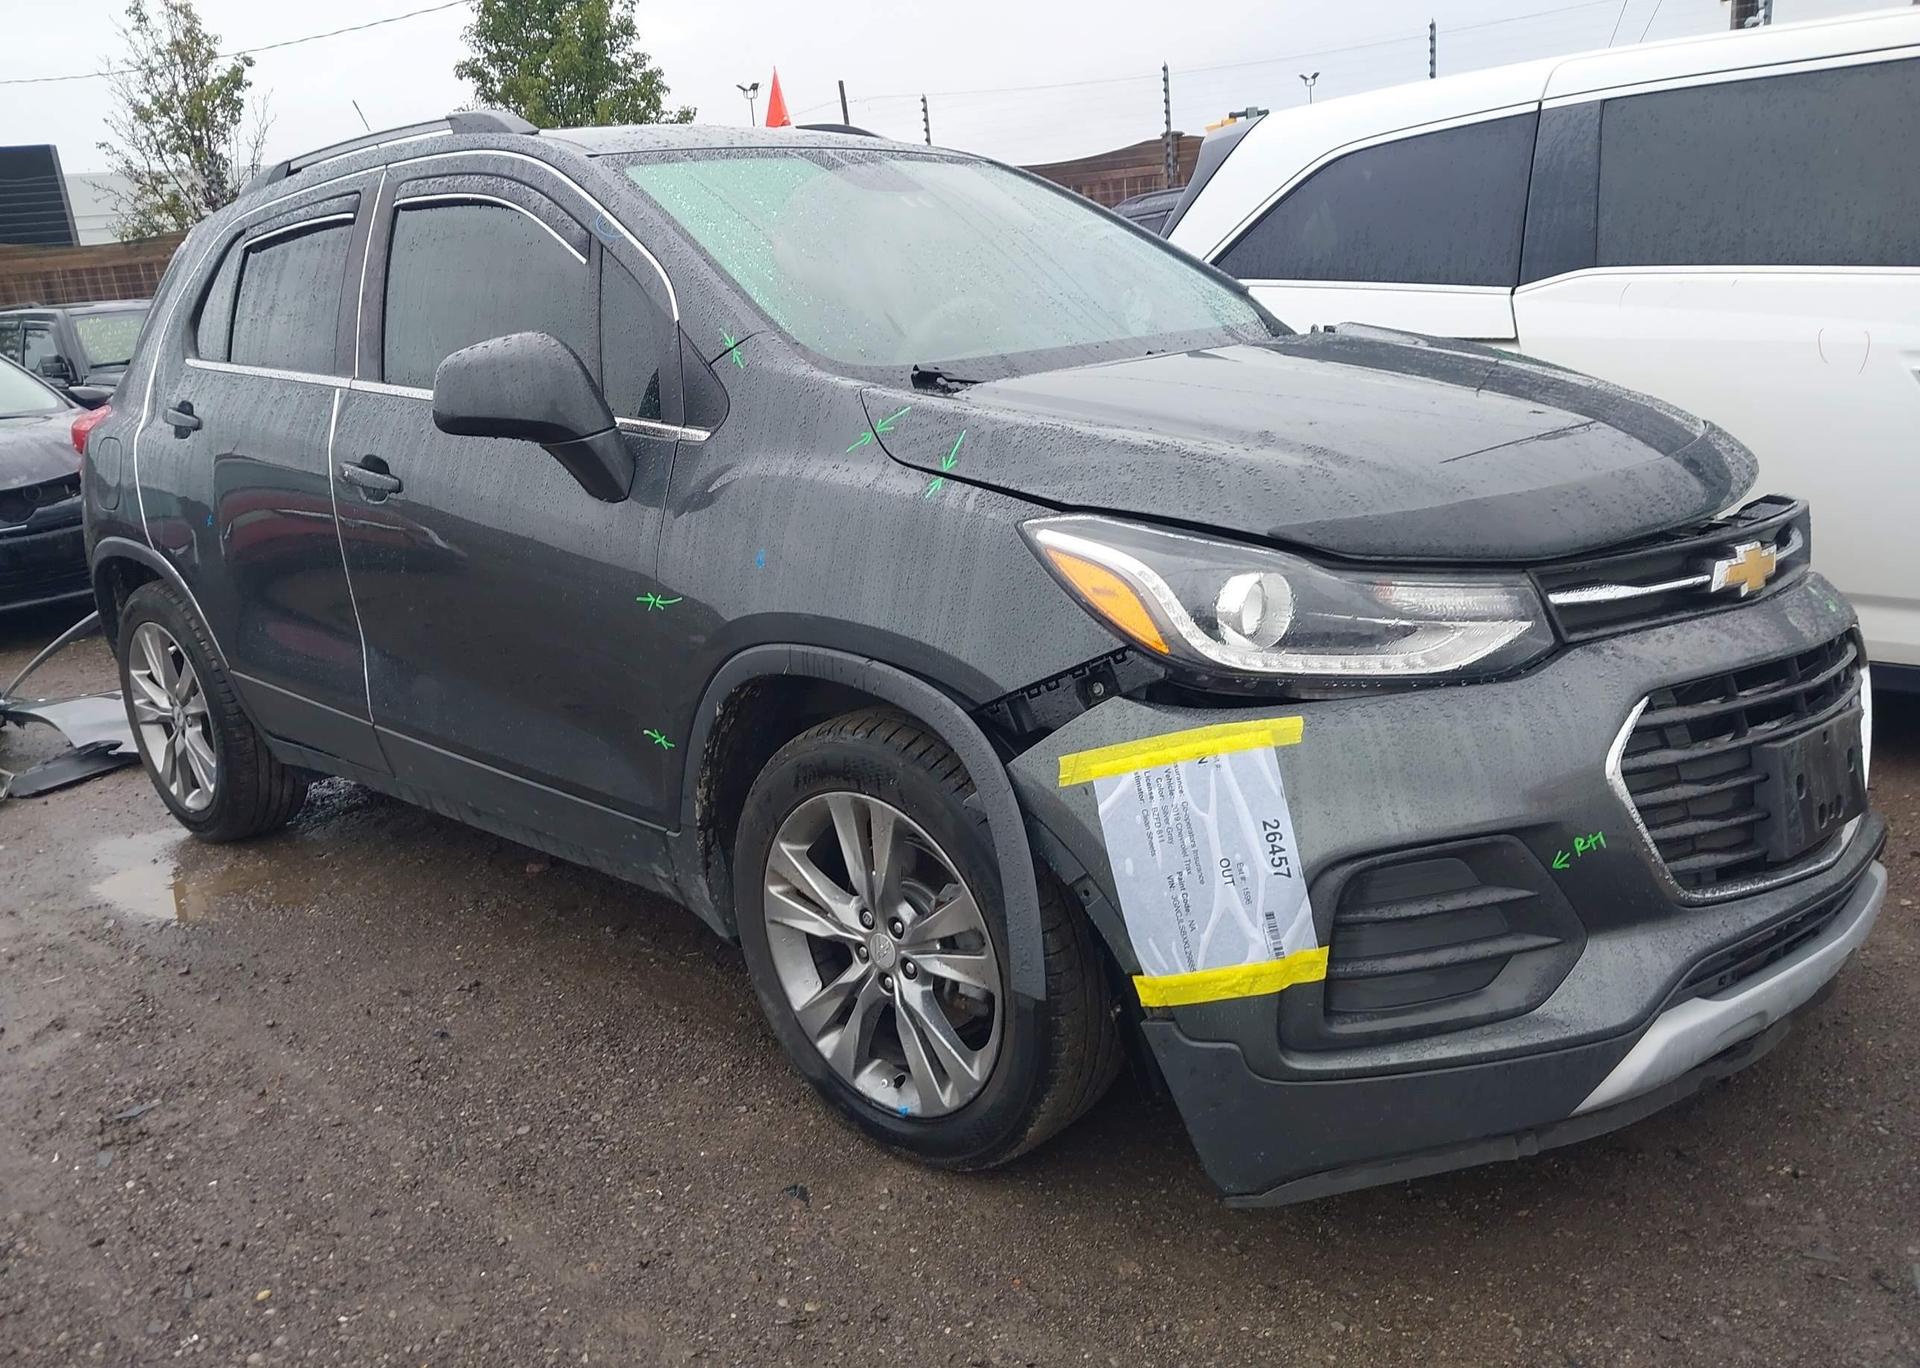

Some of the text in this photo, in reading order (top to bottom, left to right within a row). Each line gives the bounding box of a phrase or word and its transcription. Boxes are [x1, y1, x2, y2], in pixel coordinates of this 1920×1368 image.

[1144, 770, 1155, 803] License:
[1156, 777, 1174, 845] Color: Silver Gray
[1165, 768, 1175, 799] Vehicle:
[1184, 859, 1192, 875] Trax
[1262, 818, 1292, 880] 26457
[1167, 875, 1175, 892] VIN:
[1177, 871, 1186, 891] Paint
[1219, 858, 1235, 887] OUT
